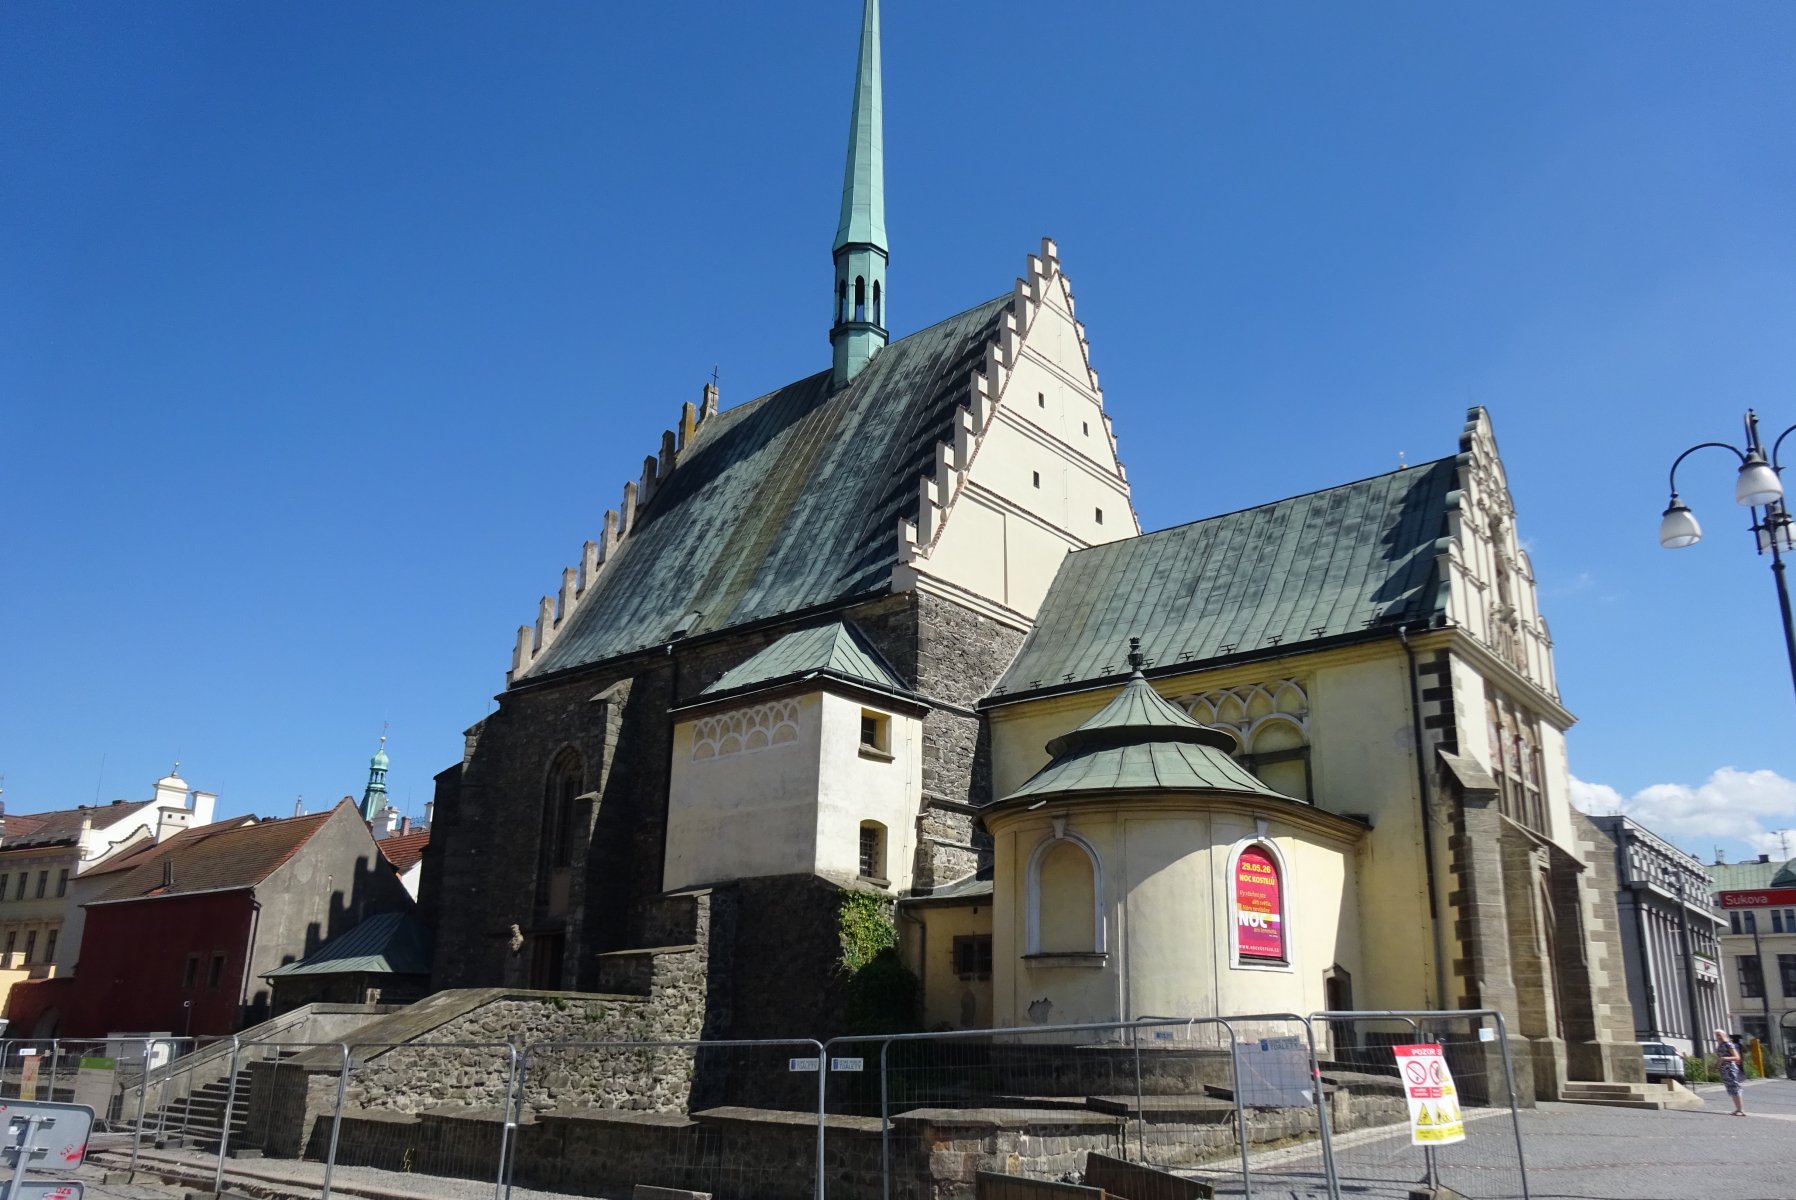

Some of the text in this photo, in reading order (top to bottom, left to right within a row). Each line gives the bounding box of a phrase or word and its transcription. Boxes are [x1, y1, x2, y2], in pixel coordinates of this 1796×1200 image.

[1241, 862, 1271, 874] 29.05.26
[1239, 874, 1252, 883] NOC
[1725, 895, 1768, 905] Sukova
[1239, 911, 1268, 929] NOC
[1270, 1042, 1299, 1050] TOALETY
[1411, 1048, 1436, 1056] POZOR
